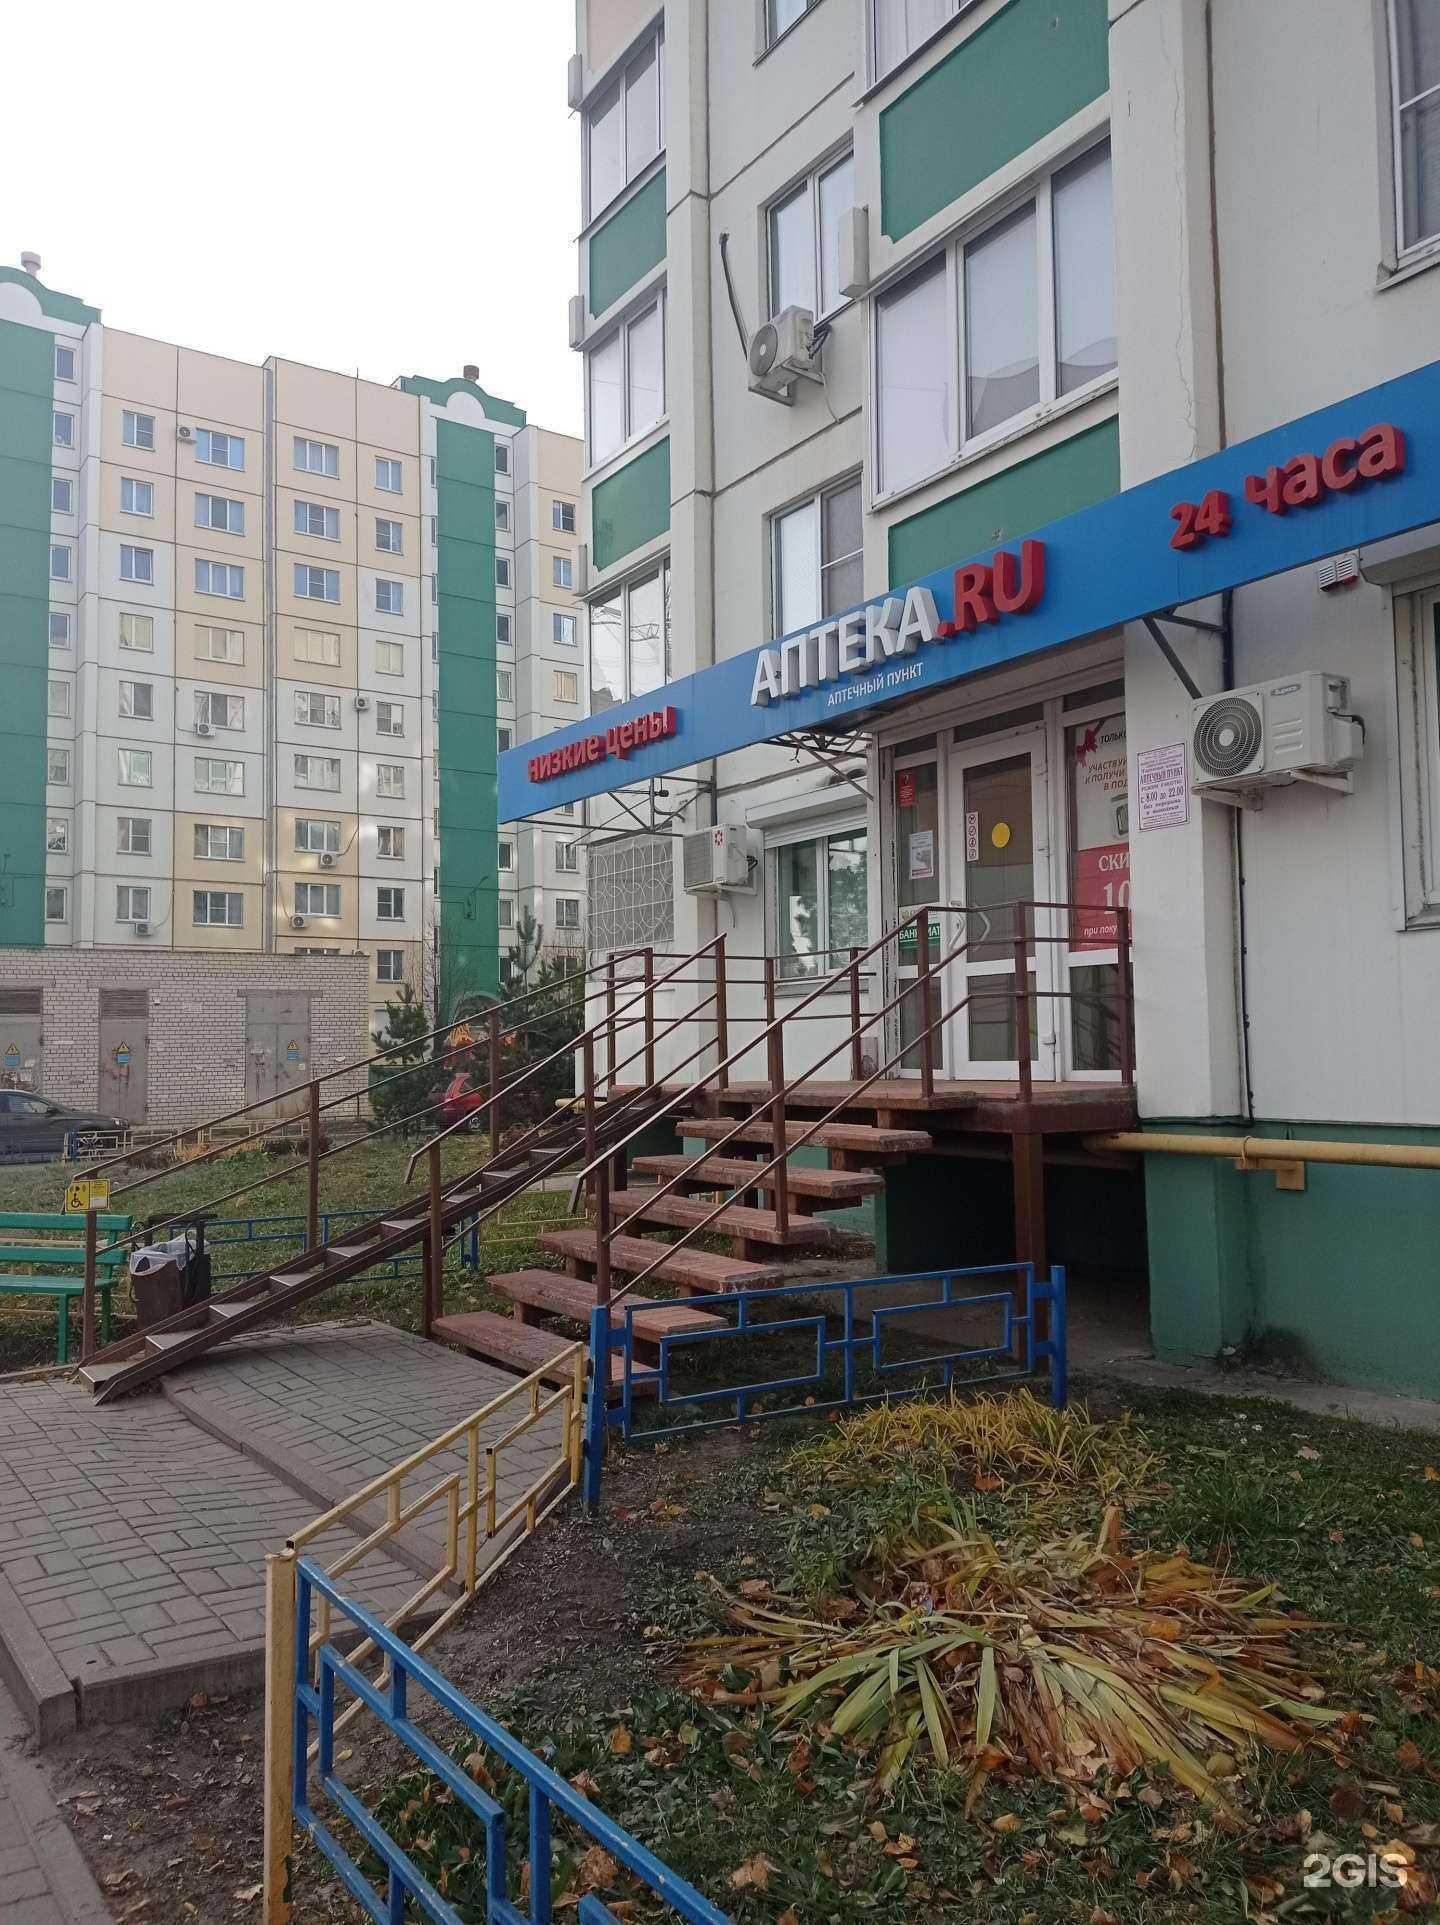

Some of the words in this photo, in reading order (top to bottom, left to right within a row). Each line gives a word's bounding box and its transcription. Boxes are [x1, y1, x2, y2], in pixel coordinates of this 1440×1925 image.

[1169, 490, 1231, 550] 24
[1244, 422, 1405, 515] часа
[752, 539, 1045, 708] АПТЕКА.RU
[827, 674, 885, 707] АПТЕЧНЫЙ
[886, 661, 924, 686] ПУНКТ
[528, 735, 605, 783] низкие
[605, 704, 676, 760] цены
[1168, 786, 1184, 798] 22.00
[1084, 928, 1098, 937] при
